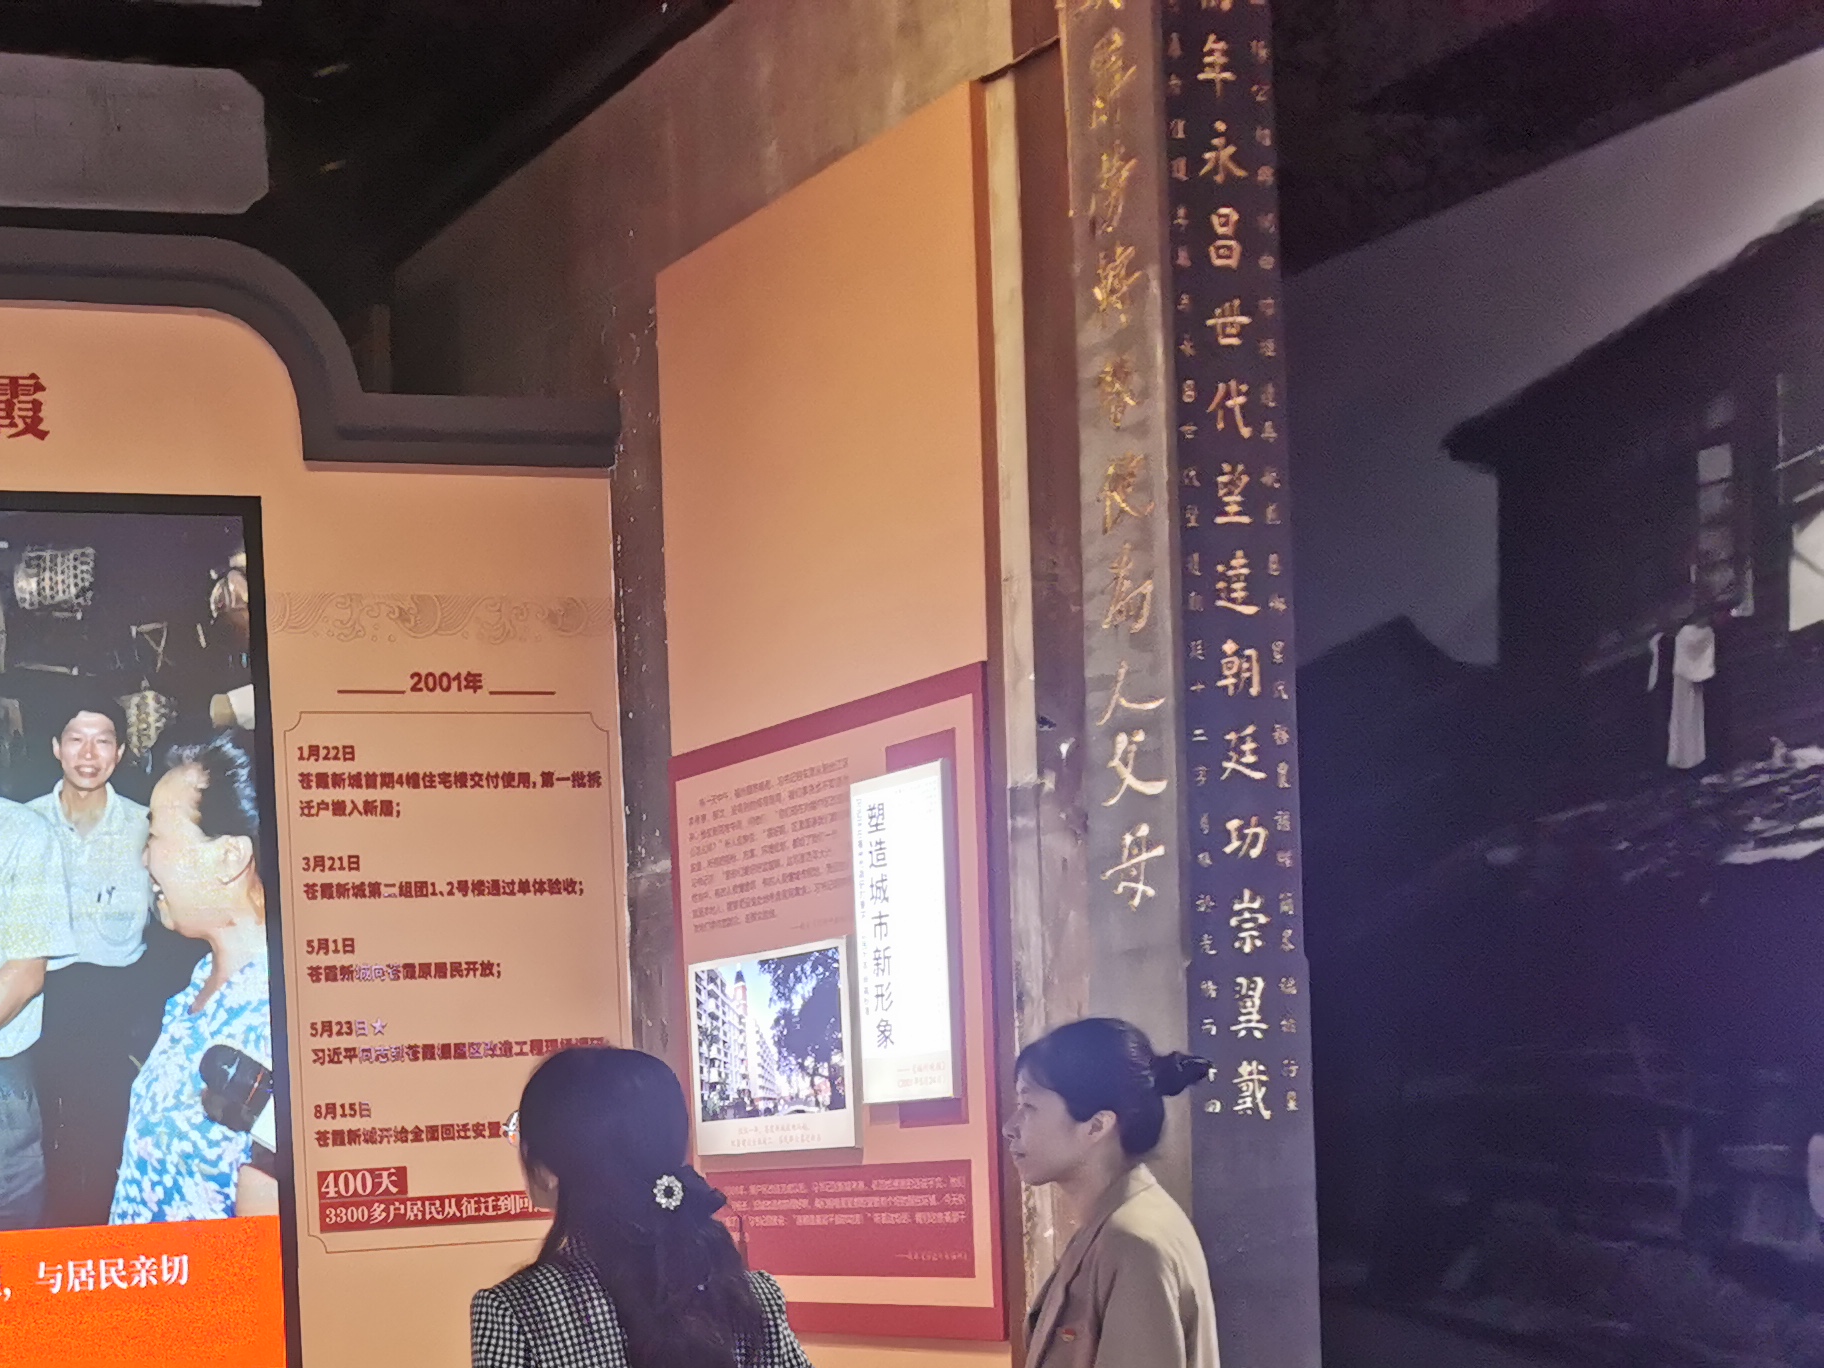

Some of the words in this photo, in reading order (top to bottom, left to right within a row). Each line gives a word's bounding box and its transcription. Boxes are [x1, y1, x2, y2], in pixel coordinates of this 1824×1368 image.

[410, 671, 483, 693] 2001年
[297, 745, 355, 762] 1月22日
[302, 855, 360, 872] 3月21日
[866, 802, 894, 1049] 塑造城市新形象
[306, 938, 355, 955] 5月1日
[310, 1020, 368, 1037] 5月23日
[314, 1102, 372, 1119] 8月15日
[321, 1168, 398, 1198] 400天
